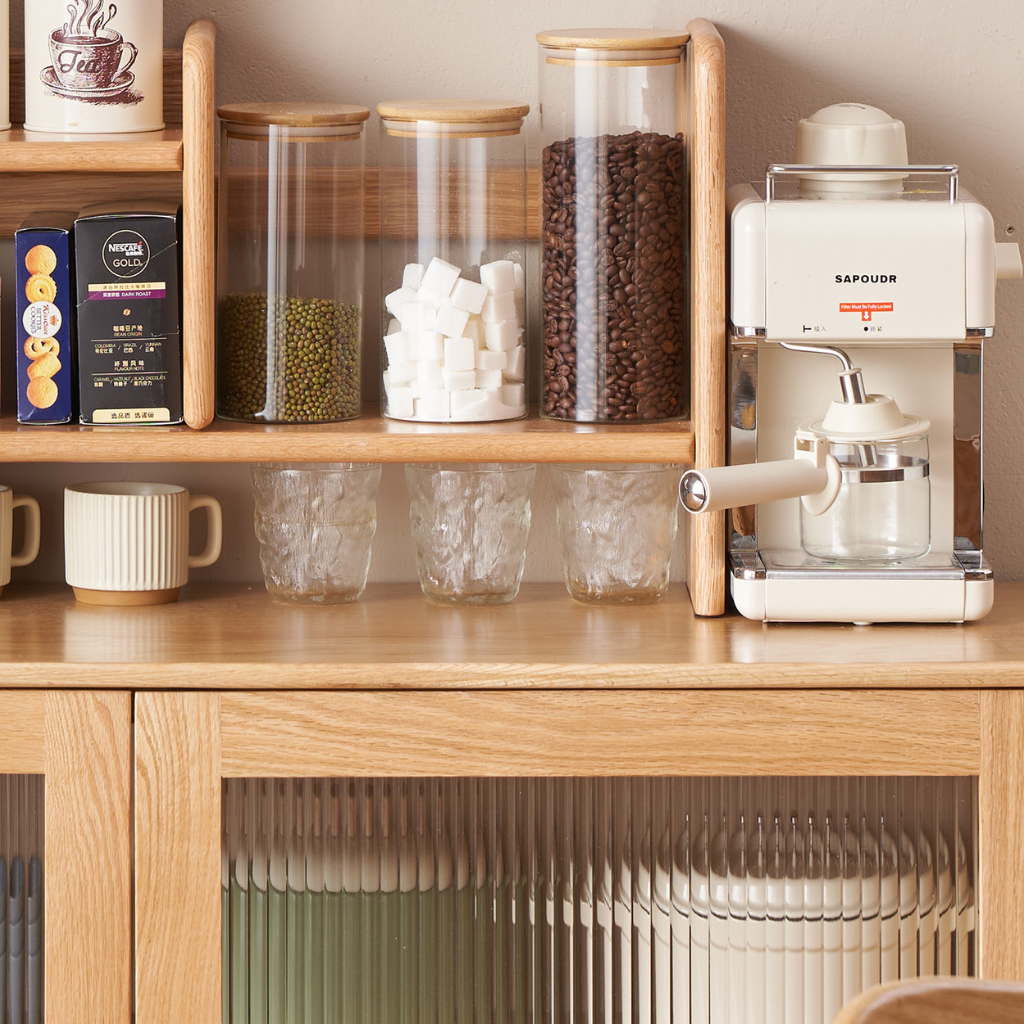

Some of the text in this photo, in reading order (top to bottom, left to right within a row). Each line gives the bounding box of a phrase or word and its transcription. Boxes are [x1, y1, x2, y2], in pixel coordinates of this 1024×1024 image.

[57, 49, 102, 74] Tea
[112, 258, 141, 267] GOLD
[834, 274, 898, 284] SAPOUDR
